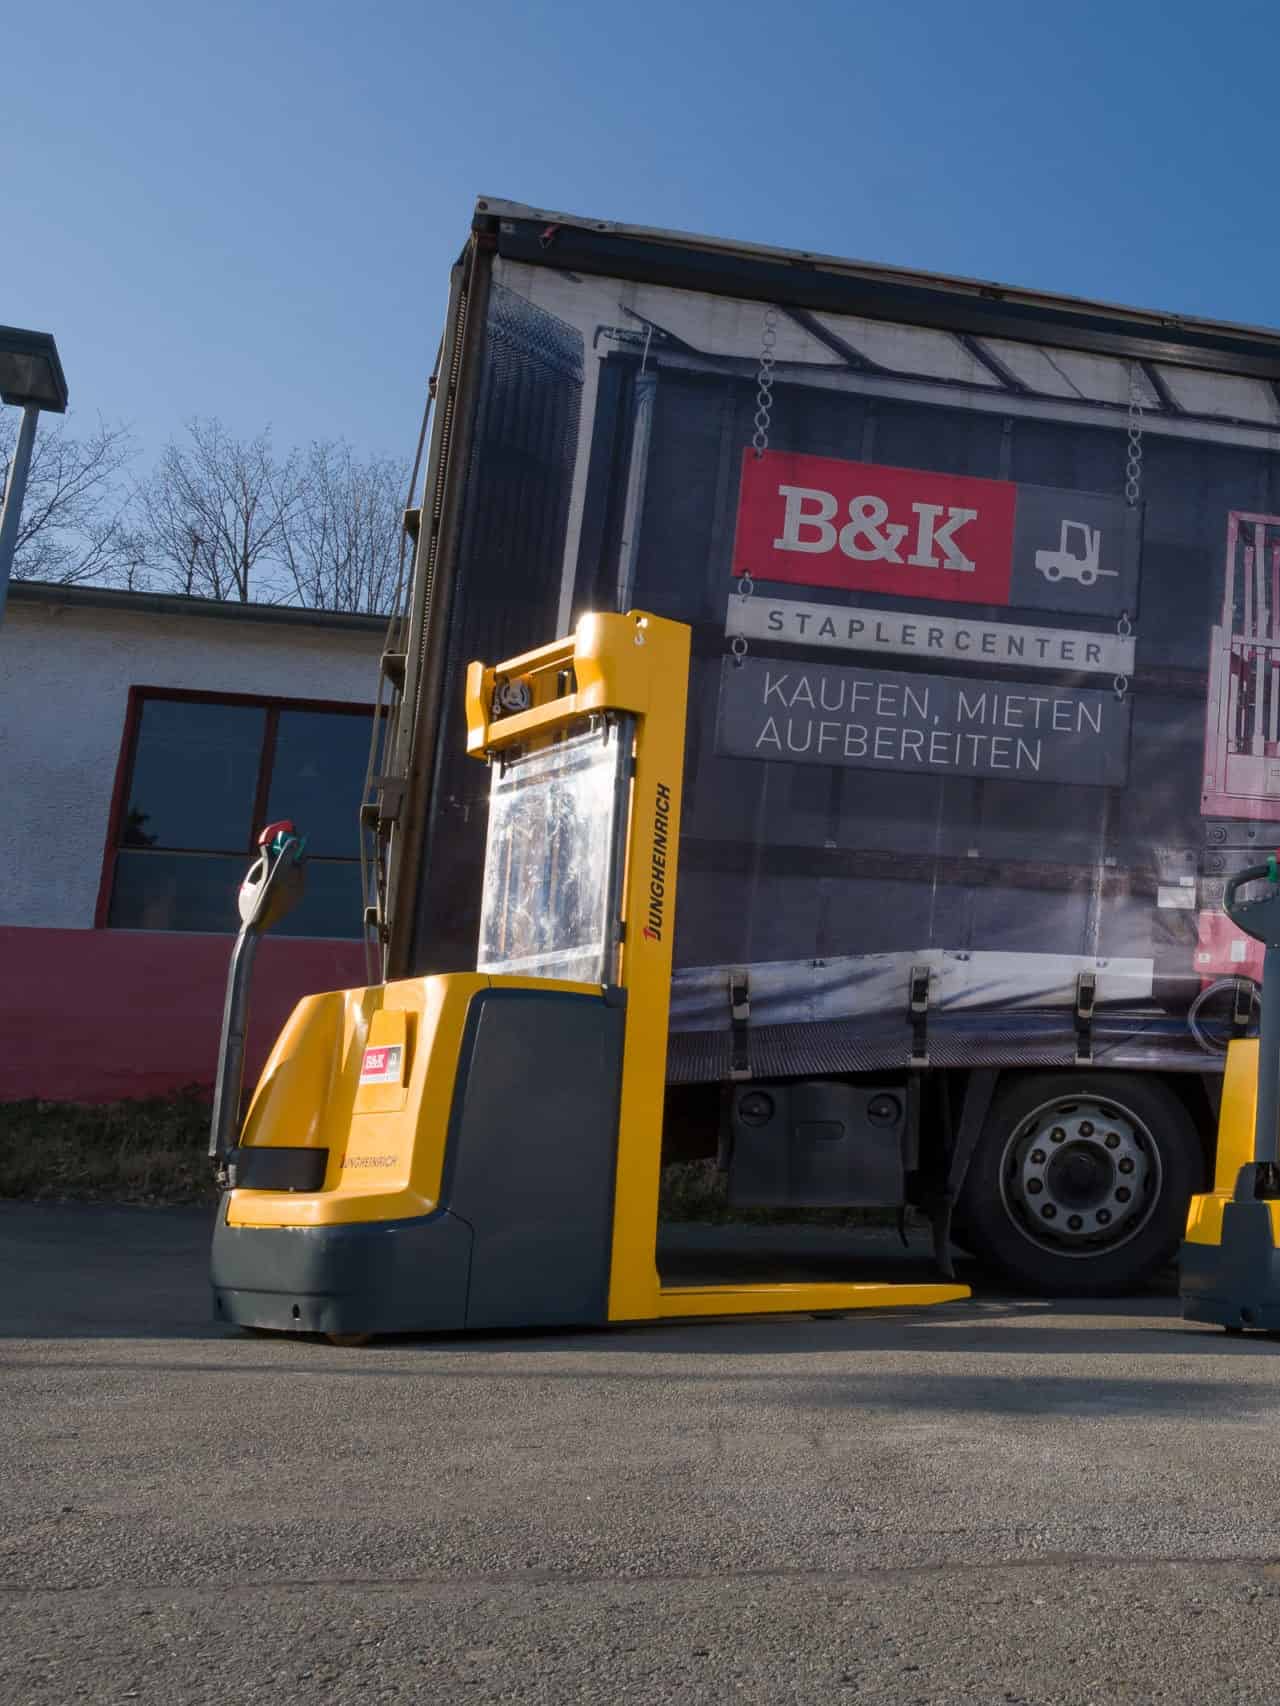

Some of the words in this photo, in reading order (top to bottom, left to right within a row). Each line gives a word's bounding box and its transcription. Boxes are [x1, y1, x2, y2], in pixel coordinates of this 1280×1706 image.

[773, 484, 978, 572] B&K
[767, 610, 1102, 663] STAPLERCENTER
[763, 672, 940, 726] KAUFEN,
[956, 691, 1103, 735] MIETEN
[755, 717, 1041, 771] AUFBEREITEN
[643, 783, 670, 942] JUNGHEINRICH
